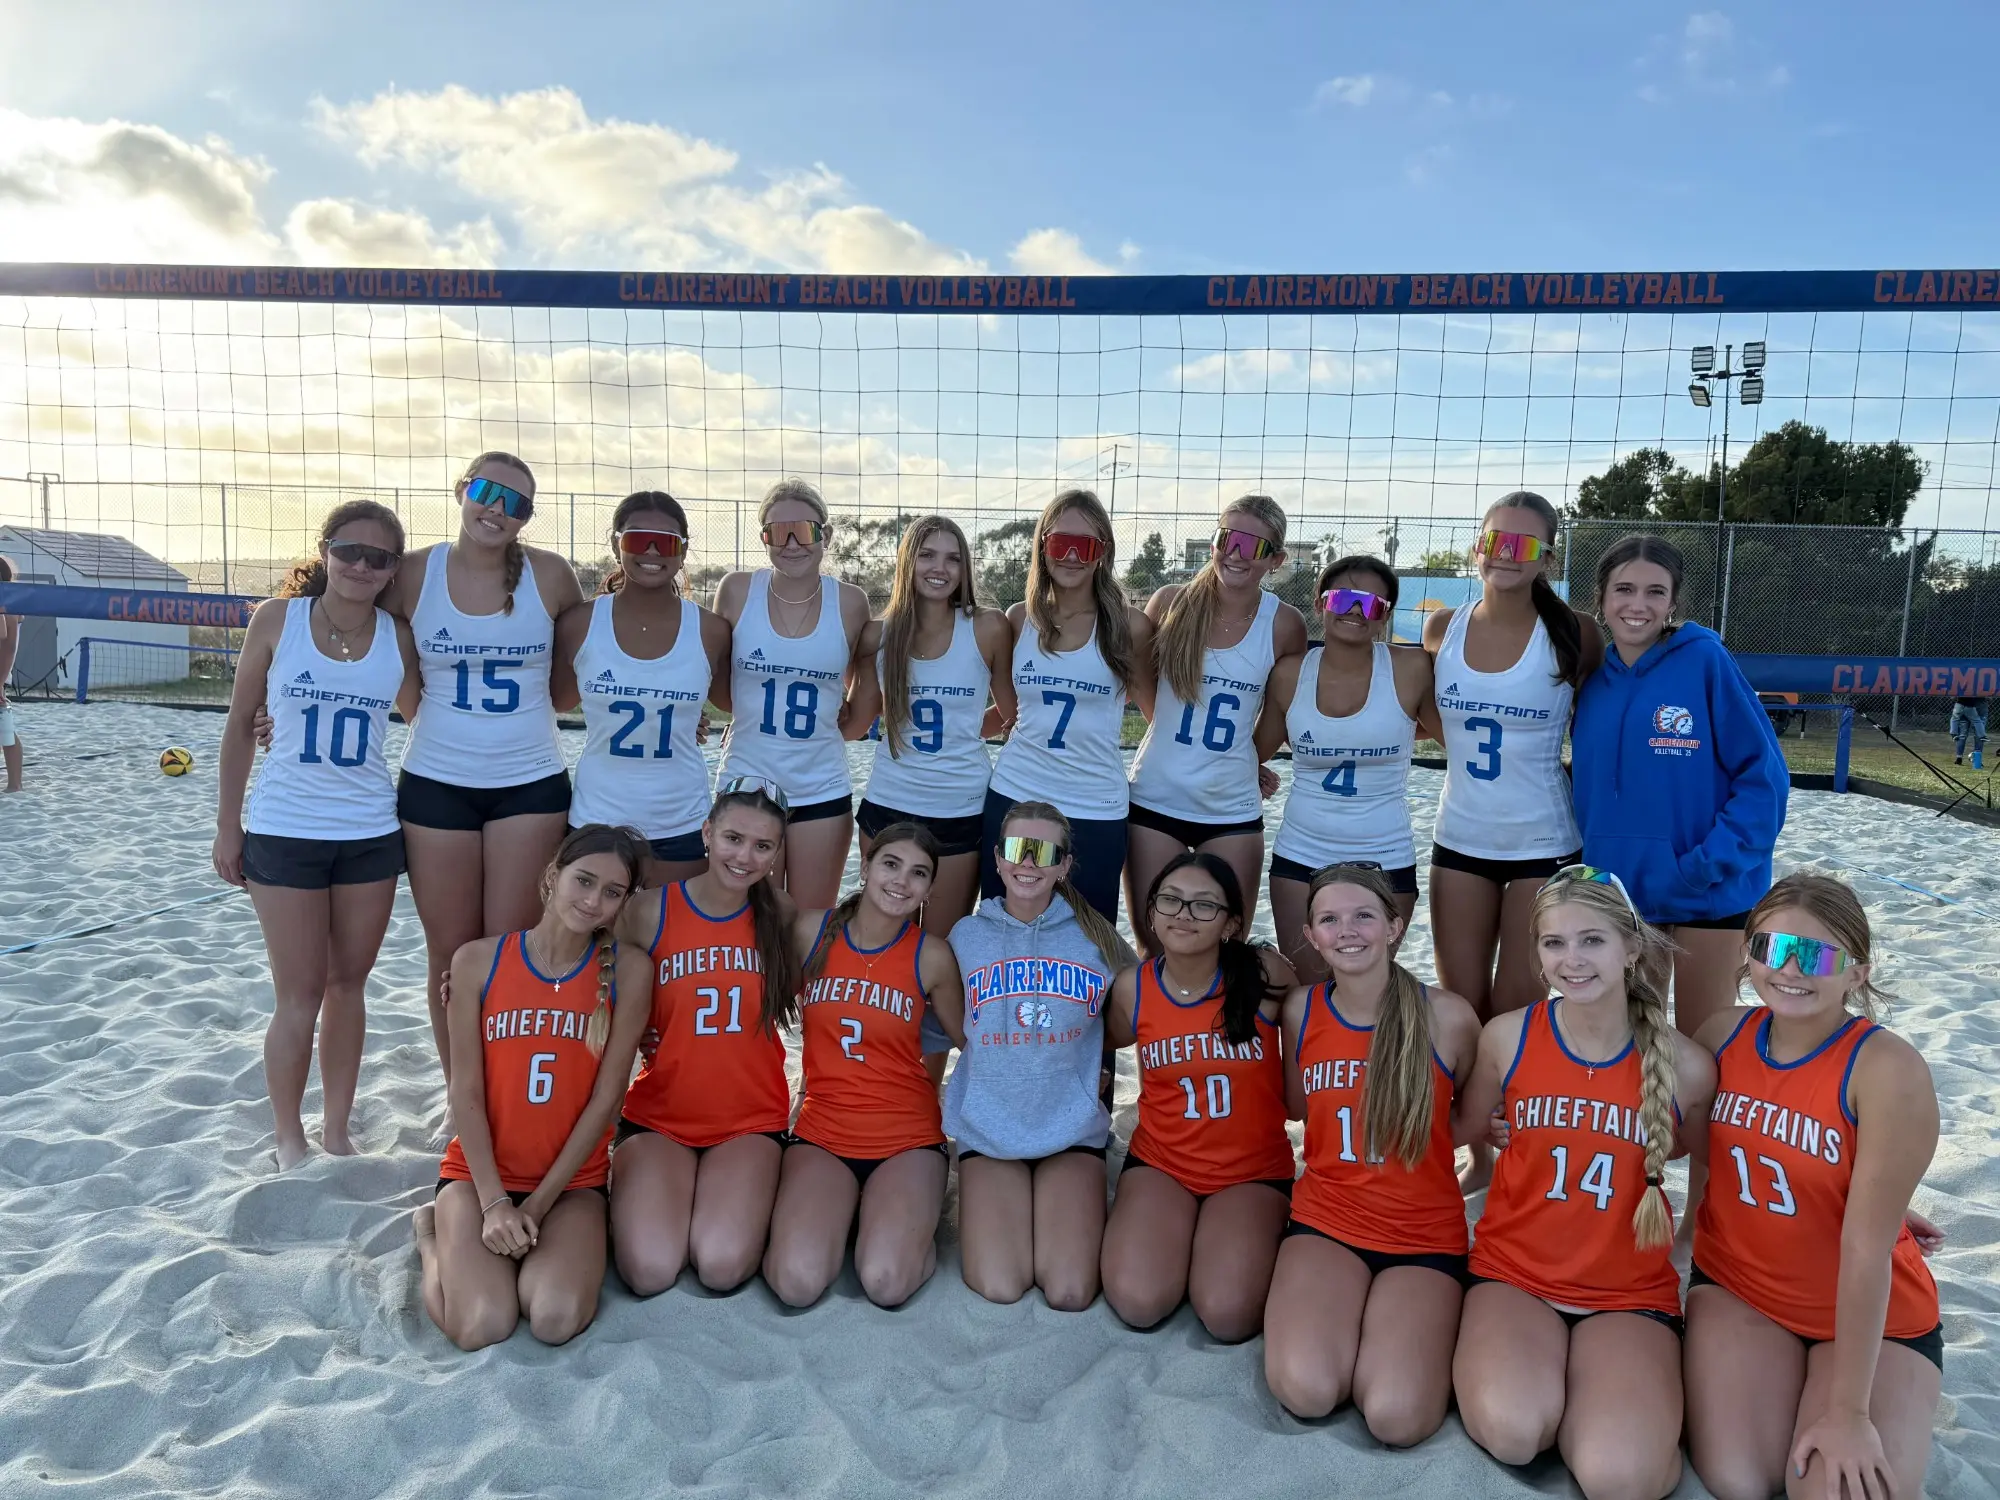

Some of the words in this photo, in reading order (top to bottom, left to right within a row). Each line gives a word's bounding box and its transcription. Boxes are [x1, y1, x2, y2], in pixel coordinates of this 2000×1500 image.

[94, 266, 246, 294] CLAIREMONT
[254, 267, 335, 297] BEACH
[343, 270, 502, 299] VOLLEYBALL
[619, 273, 791, 303] CLAIREMONT
[799, 275, 889, 305] BEACH
[898, 276, 1076, 307] VOLLEYBALL
[1203, 275, 1401, 307] CLAIREMONT
[1408, 275, 1512, 306] BEACH
[1521, 273, 1724, 305] VOLLEYBALL
[1873, 271, 2000, 303] CLAIRE
[108, 595, 242, 627] CLAIREMON
[431, 642, 547, 656] CHIEFTAINS
[450, 659, 524, 713] 15
[593, 683, 699, 701] CHIEFTAINS
[743, 661, 840, 681] CHIEFTAINS
[1019, 675, 1112, 695] CHIEFTAINS
[1832, 664, 2000, 697] CLAIREMO
[290, 687, 392, 709] CHIEFTAINS
[759, 677, 819, 739] 18
[1440, 697, 1550, 719] CHIEFTAINS
[299, 703, 372, 768] 10
[608, 700, 675, 759] 21
[911, 699, 944, 754] 9
[1041, 690, 1077, 750] 7
[1174, 692, 1241, 753] 16
[1297, 744, 1401, 757] CHIEFTAINS
[1464, 716, 1503, 782] 3
[1321, 760, 1358, 798] 4
[659, 945, 765, 986] CHIEFTAIN
[695, 985, 743, 1036] 21
[803, 976, 914, 1023] CHIEFTAINS
[967, 956, 1107, 1027] CLAIREMONT
[486, 1007, 594, 1042] CHIEFTAI
[840, 1017, 866, 1063] 2
[981, 1028, 1083, 1046] CHIEFTAINS
[1141, 1032, 1265, 1071] CHIEFTAINS
[527, 1051, 558, 1105] 6
[1178, 1073, 1232, 1120] 10
[1515, 1094, 1650, 1149] CHIEFTAIN
[1709, 1090, 1843, 1165] HIEFTAINS
[1545, 1145, 1616, 1212] 14
[1729, 1144, 1798, 1217] 13
